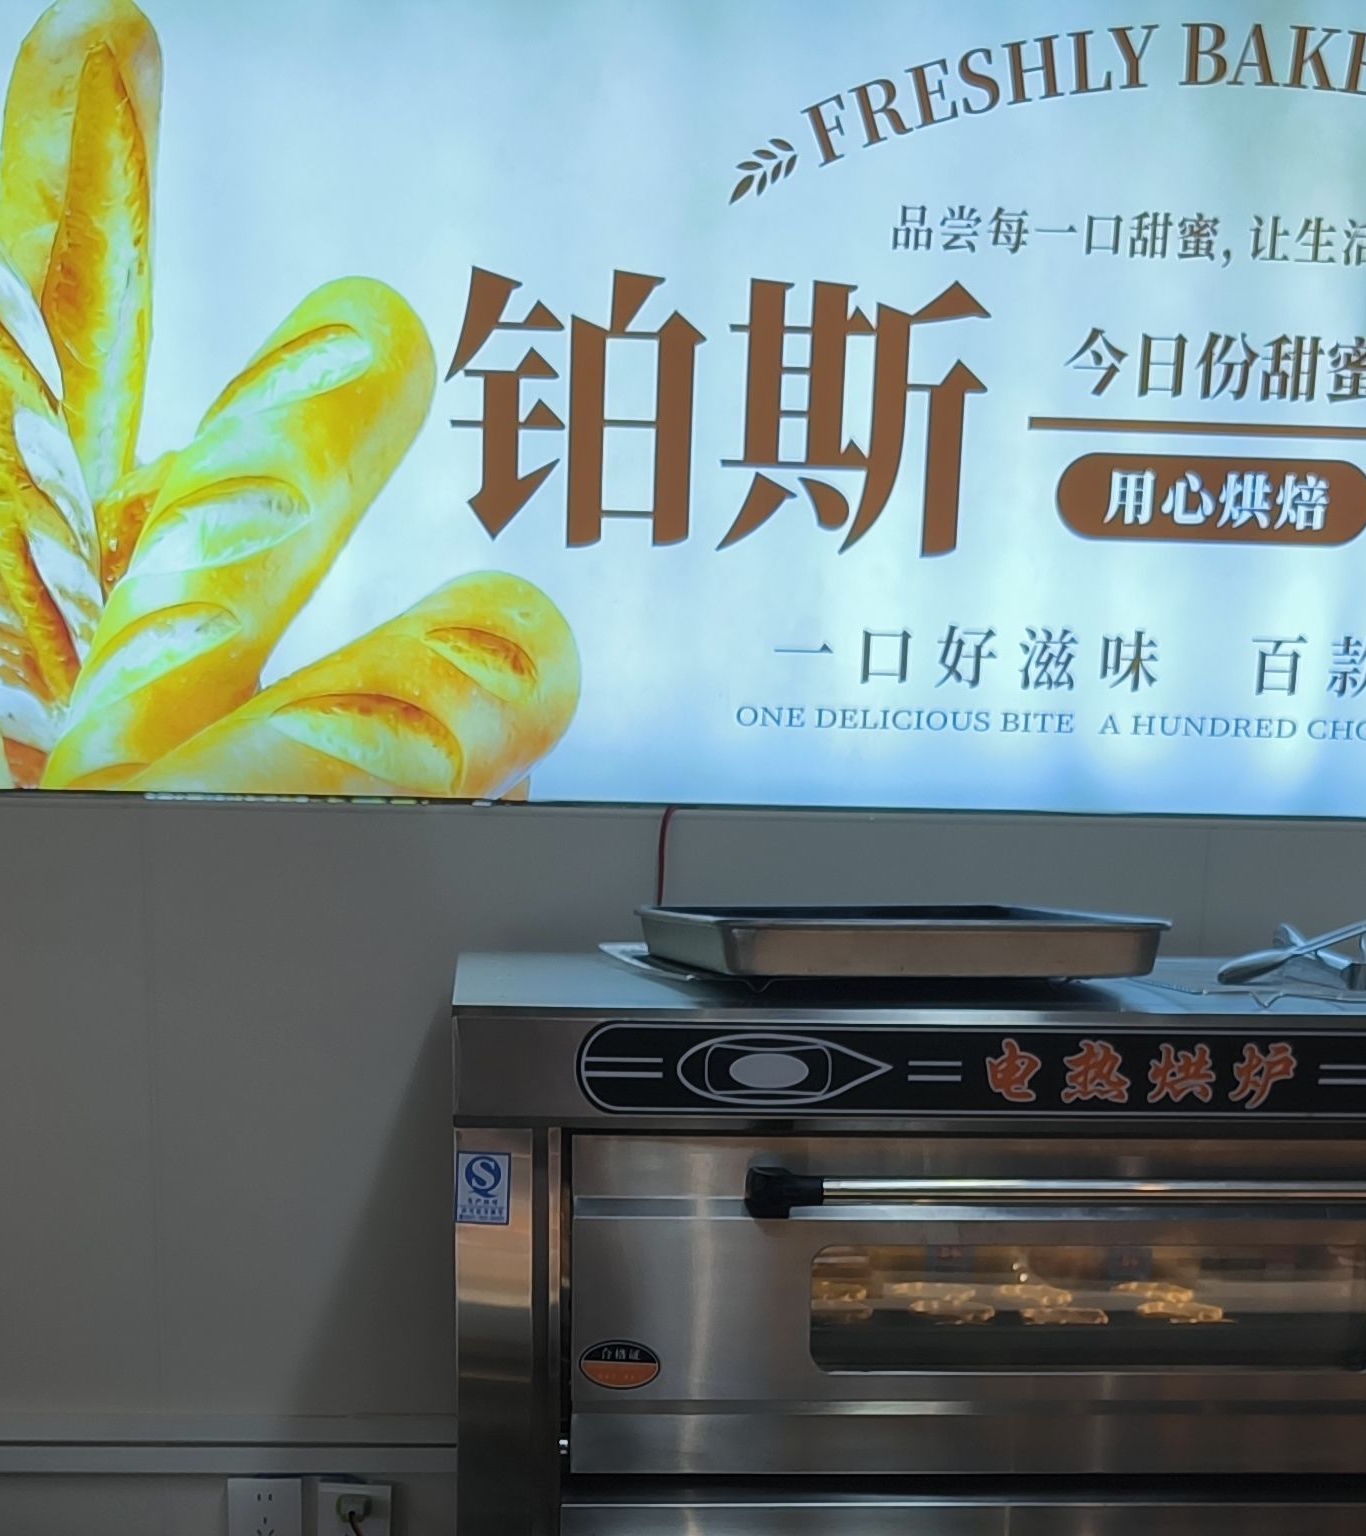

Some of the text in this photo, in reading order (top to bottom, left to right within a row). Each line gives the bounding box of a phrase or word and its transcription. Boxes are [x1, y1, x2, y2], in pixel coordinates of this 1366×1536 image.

[801, 22, 1159, 168] FRESHLY
[444, 263, 993, 559] 铂斯
[1102, 464, 1331, 535] 用心烘焙
[771, 623, 1162, 696] 一口好滋味
[735, 703, 806, 732] ONE
[812, 705, 992, 735] DELICIOUS
[998, 709, 1077, 736] BITE
[1099, 711, 1121, 737] A
[1128, 713, 1300, 742] HUNDRED
[985, 1040, 1298, 1109] 电热烘炉
